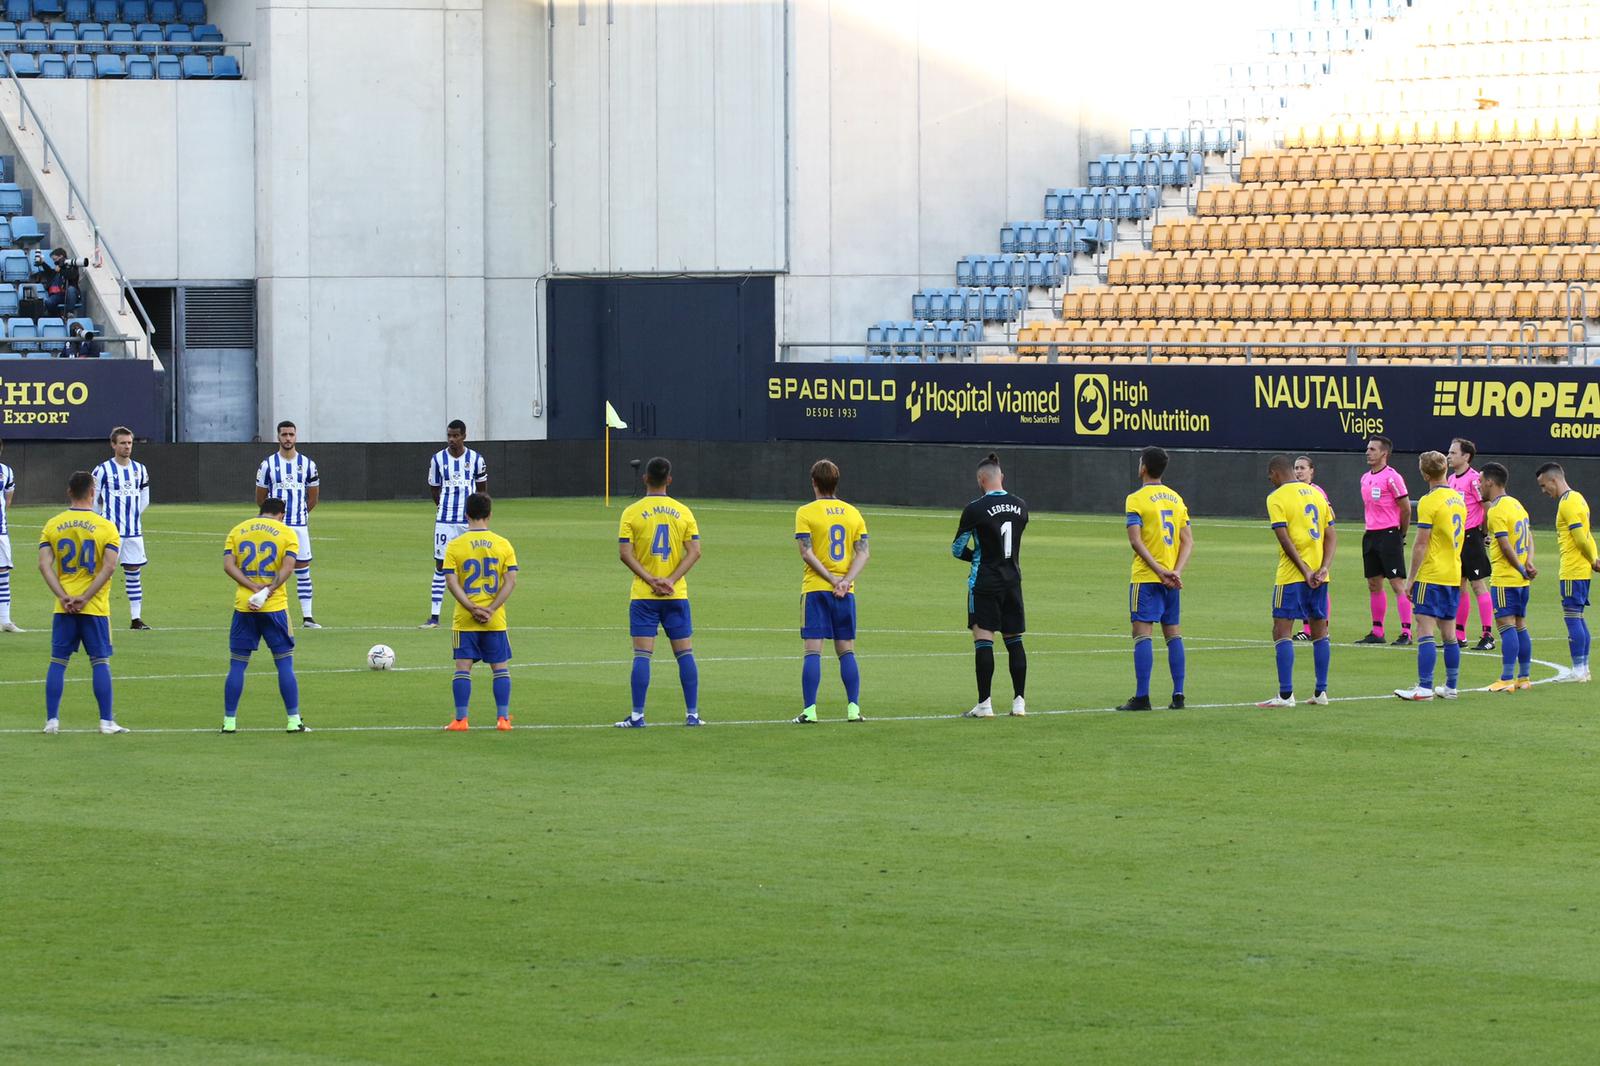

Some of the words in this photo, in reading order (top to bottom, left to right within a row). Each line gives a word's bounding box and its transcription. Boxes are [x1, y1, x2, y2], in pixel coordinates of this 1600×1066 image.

[0, 376, 89, 405] HICO
[768, 378, 896, 401] SPAGNOLO
[926, 380, 992, 419] Hospital
[996, 381, 1060, 413] viamed
[1113, 380, 1148, 407] High
[1254, 375, 1383, 410] NAUTALIA
[806, 407, 834, 417] DESDE
[838, 408, 857, 418] 1933
[1340, 411, 1384, 440] Viajes
[1550, 422, 1600, 439] GROUP
[653, 506, 680, 519] MAURO
[826, 507, 845, 515] ALEX
[987, 504, 1021, 517] LEDESMA
[1304, 503, 1320, 540] 3
[250, 523, 280, 536] ESPINO
[436, 533, 447, 545] 19
[1000, 521, 1013, 559] 1
[1160, 509, 1175, 545] 5
[57, 537, 97, 575] 24
[652, 523, 672, 561] 4
[830, 523, 845, 561] 8
[239, 540, 277, 577] 22
[463, 557, 499, 595] 25
